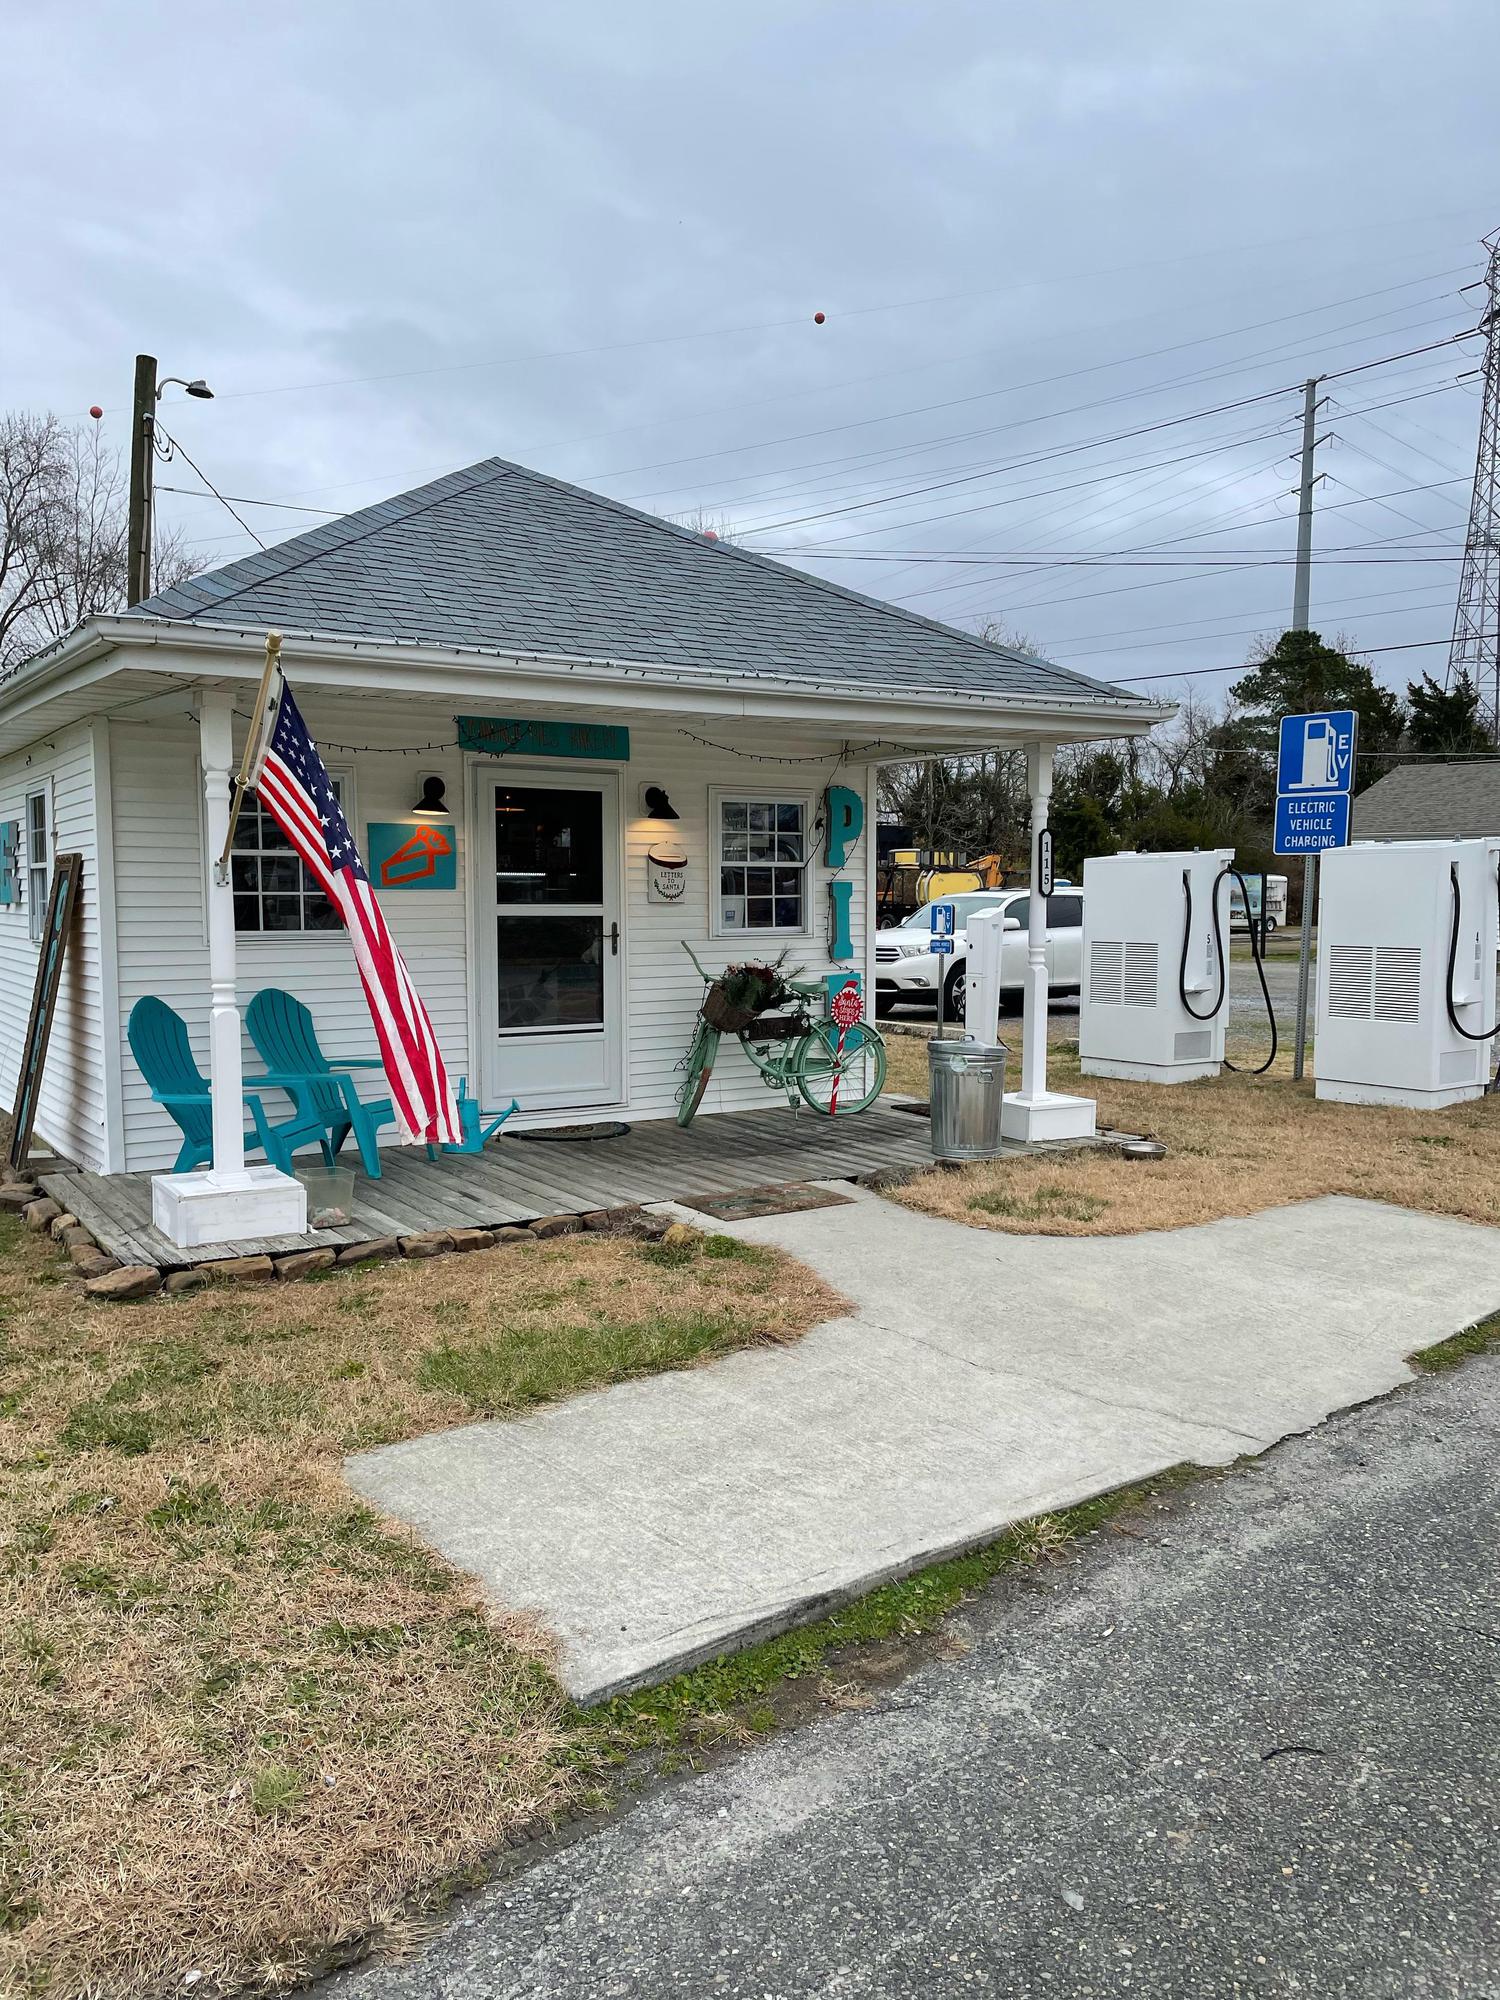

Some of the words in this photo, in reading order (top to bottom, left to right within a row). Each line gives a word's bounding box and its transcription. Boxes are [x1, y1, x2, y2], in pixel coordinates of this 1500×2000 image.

[1337, 734, 1350, 769] EV
[1288, 801, 1336, 814] ELECTRIC
[1290, 818, 1333, 831] VEHICLE
[1284, 835, 1336, 848] CHARGING
[660, 871, 684, 879] LETTERS
[838, 1014, 854, 1022] HERE
